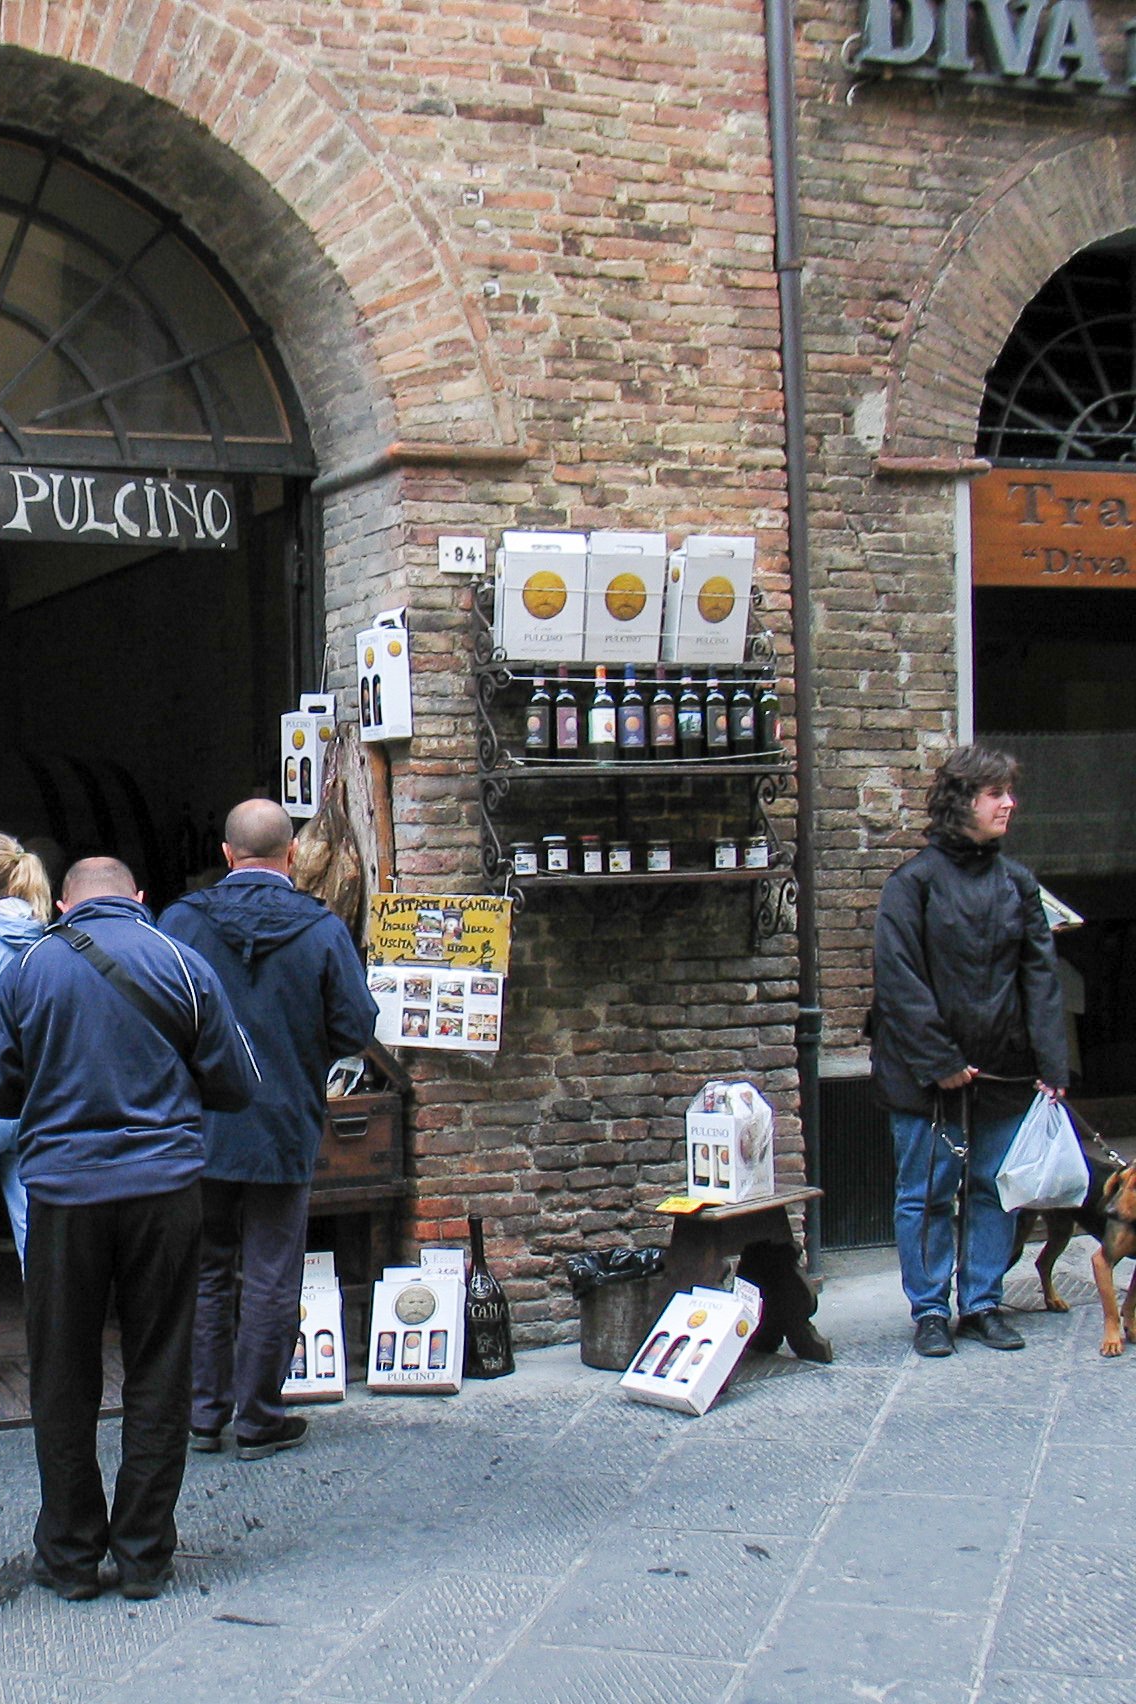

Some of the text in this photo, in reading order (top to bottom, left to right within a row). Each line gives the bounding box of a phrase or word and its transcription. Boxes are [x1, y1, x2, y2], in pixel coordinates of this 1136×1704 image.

[857, 0, 1110, 83] DIVA
[2, 466, 232, 540] PULCINO
[1007, 481, 1133, 530] Tra
[523, 633, 563, 642] PULCINO
[690, 1126, 730, 1138] PULCINO
[387, 1371, 436, 1382] PULCINO
